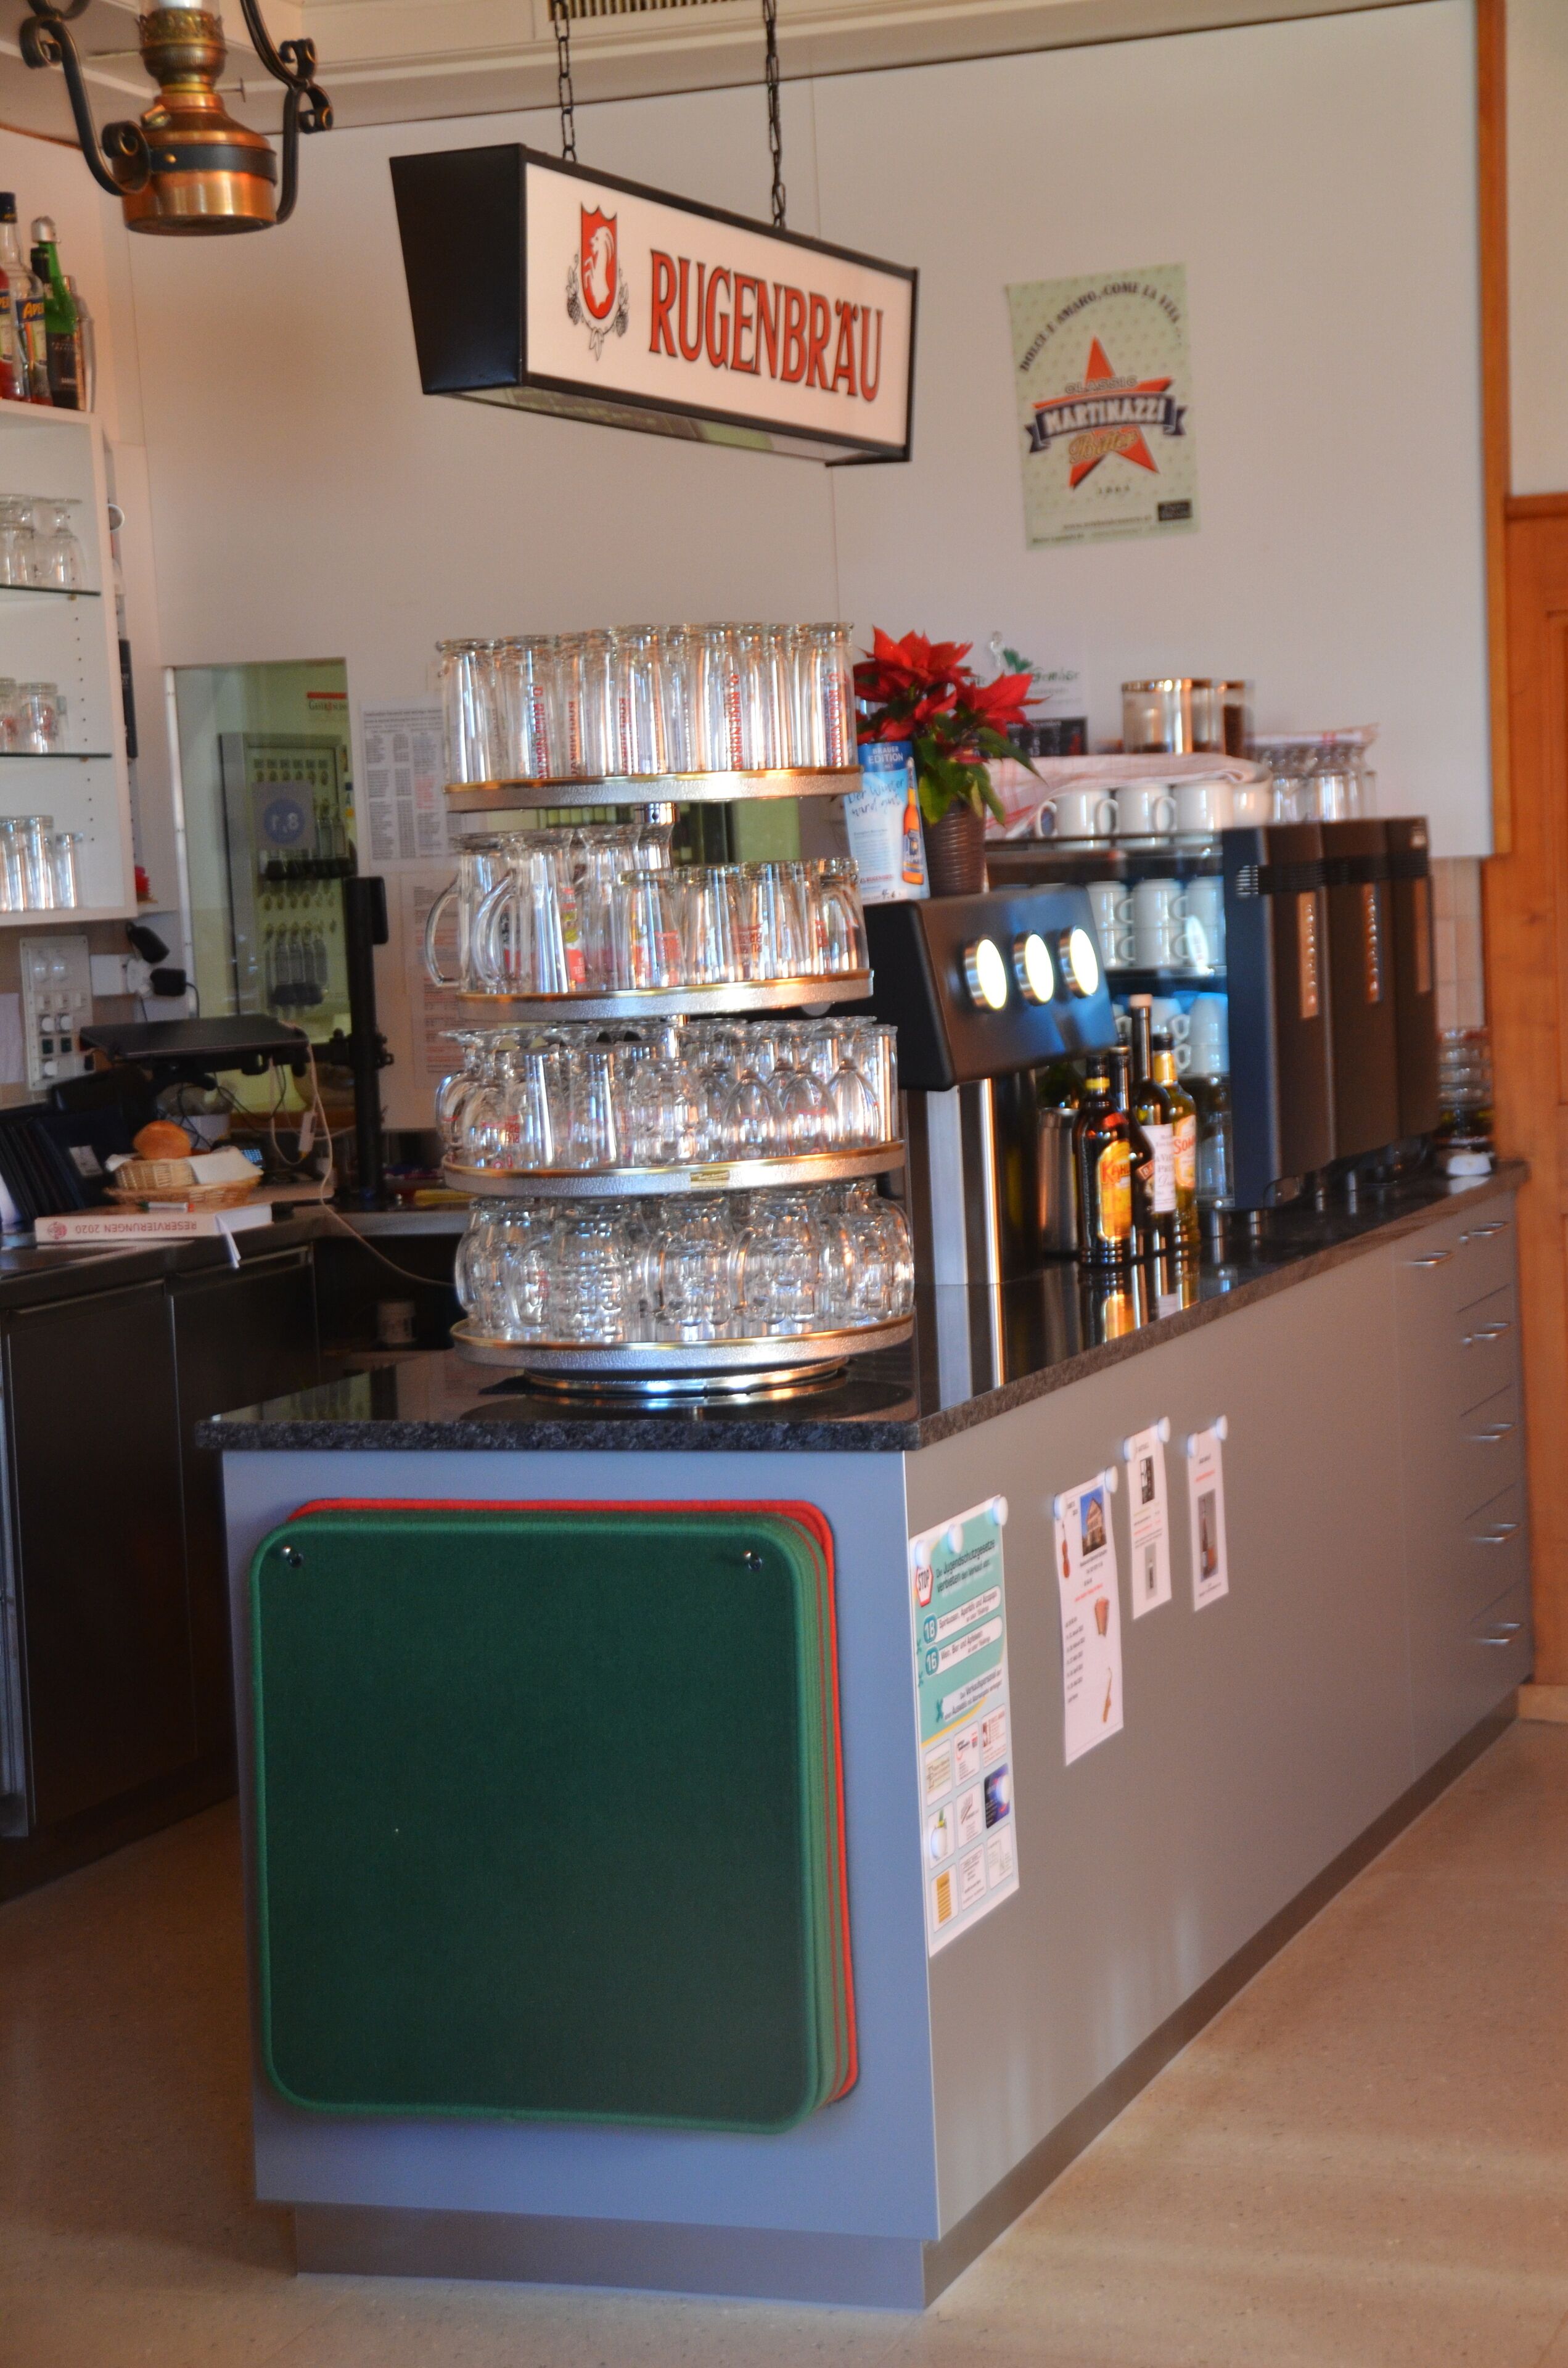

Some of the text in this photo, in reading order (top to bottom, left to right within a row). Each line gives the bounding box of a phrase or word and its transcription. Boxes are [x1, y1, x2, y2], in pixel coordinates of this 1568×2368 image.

[649, 249, 884, 403] RUGENBRÄU
[1065, 375, 1138, 394] CLASSIC
[1044, 397, 1166, 434] MARTINAZZI
[1069, 429, 1139, 464] Bitter
[868, 752, 903, 764] EDITION
[75, 1223, 99, 1235] 2020
[104, 1220, 197, 1233] RESERVIERUNGEN
[918, 1569, 930, 1592] STOP
[924, 1619, 936, 1642] 18
[926, 1651, 938, 1674] 16
